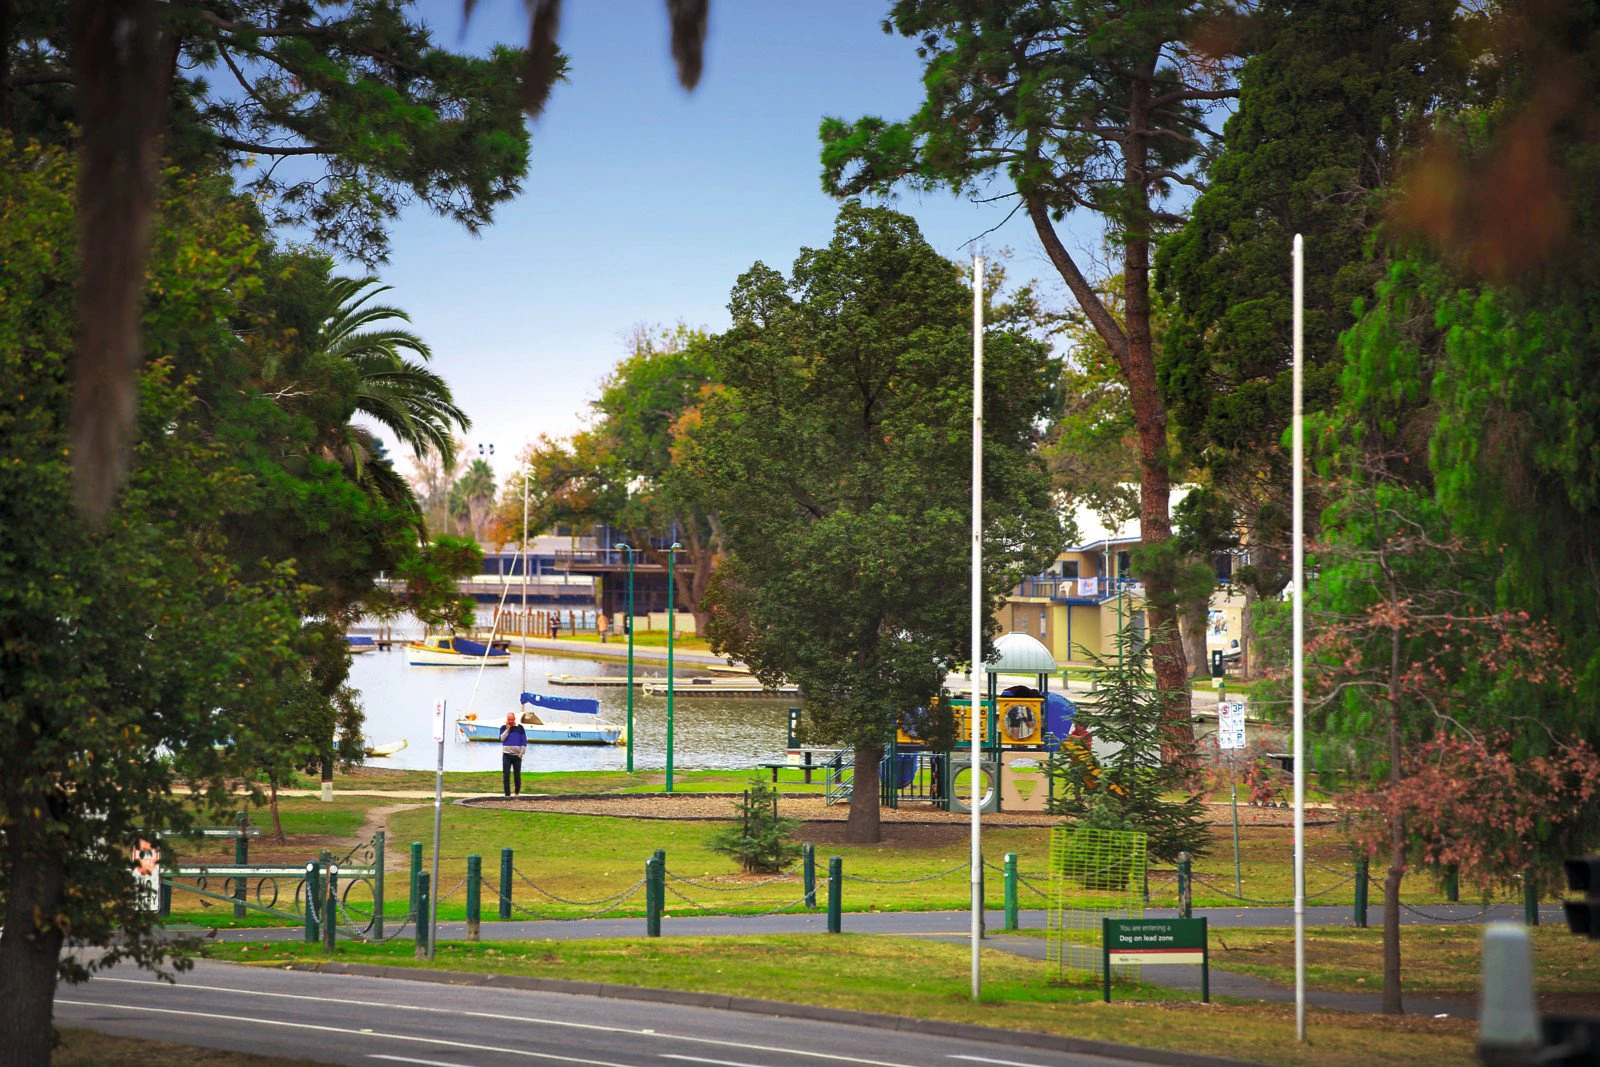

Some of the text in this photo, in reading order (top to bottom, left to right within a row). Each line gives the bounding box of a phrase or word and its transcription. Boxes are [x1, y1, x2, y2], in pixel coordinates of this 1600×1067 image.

[1233, 703, 1243, 713] 3P
[1142, 925, 1166, 933] entering
[1119, 934, 1133, 943] Dog
